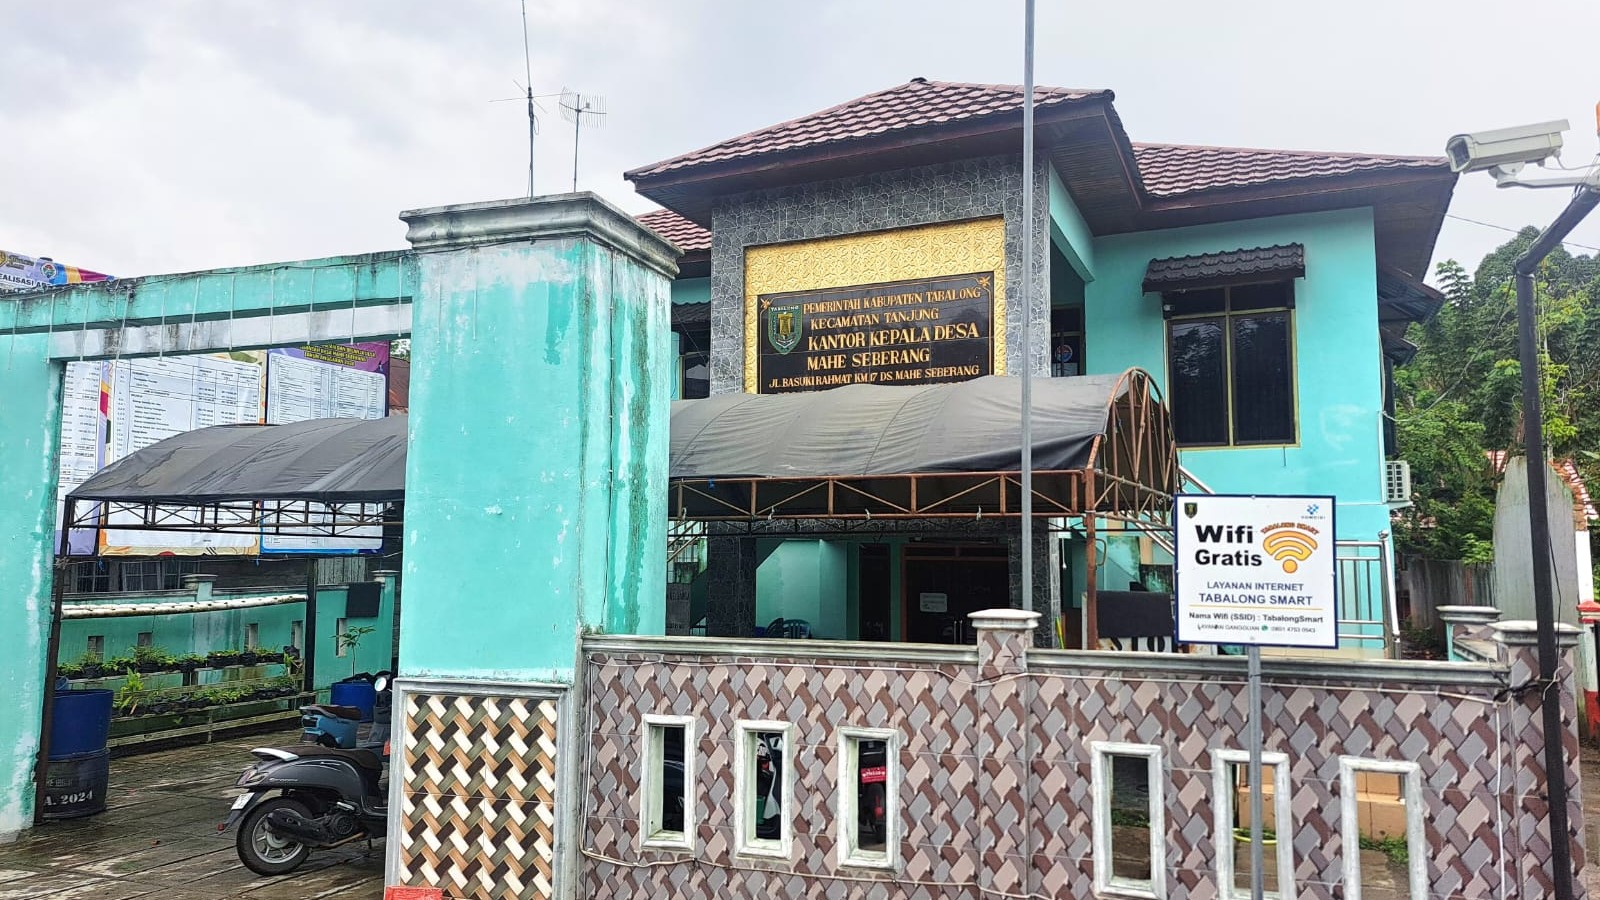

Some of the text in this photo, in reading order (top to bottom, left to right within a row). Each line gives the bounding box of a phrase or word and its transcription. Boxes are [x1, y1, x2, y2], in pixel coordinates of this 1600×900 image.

[0, 273, 34, 286] EALISASI
[803, 286, 981, 315] PEMERINTAH KABUPATEN TABALONG
[811, 308, 939, 330] KECAMATAN TANJUNG
[808, 322, 980, 351] KANTOR KEPALA DESA
[807, 348, 931, 371] MAHE SEBERANG
[816, 373, 852, 386] RAHMAT
[894, 368, 922, 380] MAHE
[924, 365, 980, 379] SEBERANG
[1195, 525, 1253, 543] Wifi
[1195, 549, 1262, 566] Gratis
[1207, 581, 1304, 591] LAYANAN INTERNET
[1199, 593, 1313, 605] TABALONG SMART
[1230, 613, 1256, 621] (SSID)
[1263, 614, 1323, 623] TabalongSmart
[60, 790, 92, 803] 2024
